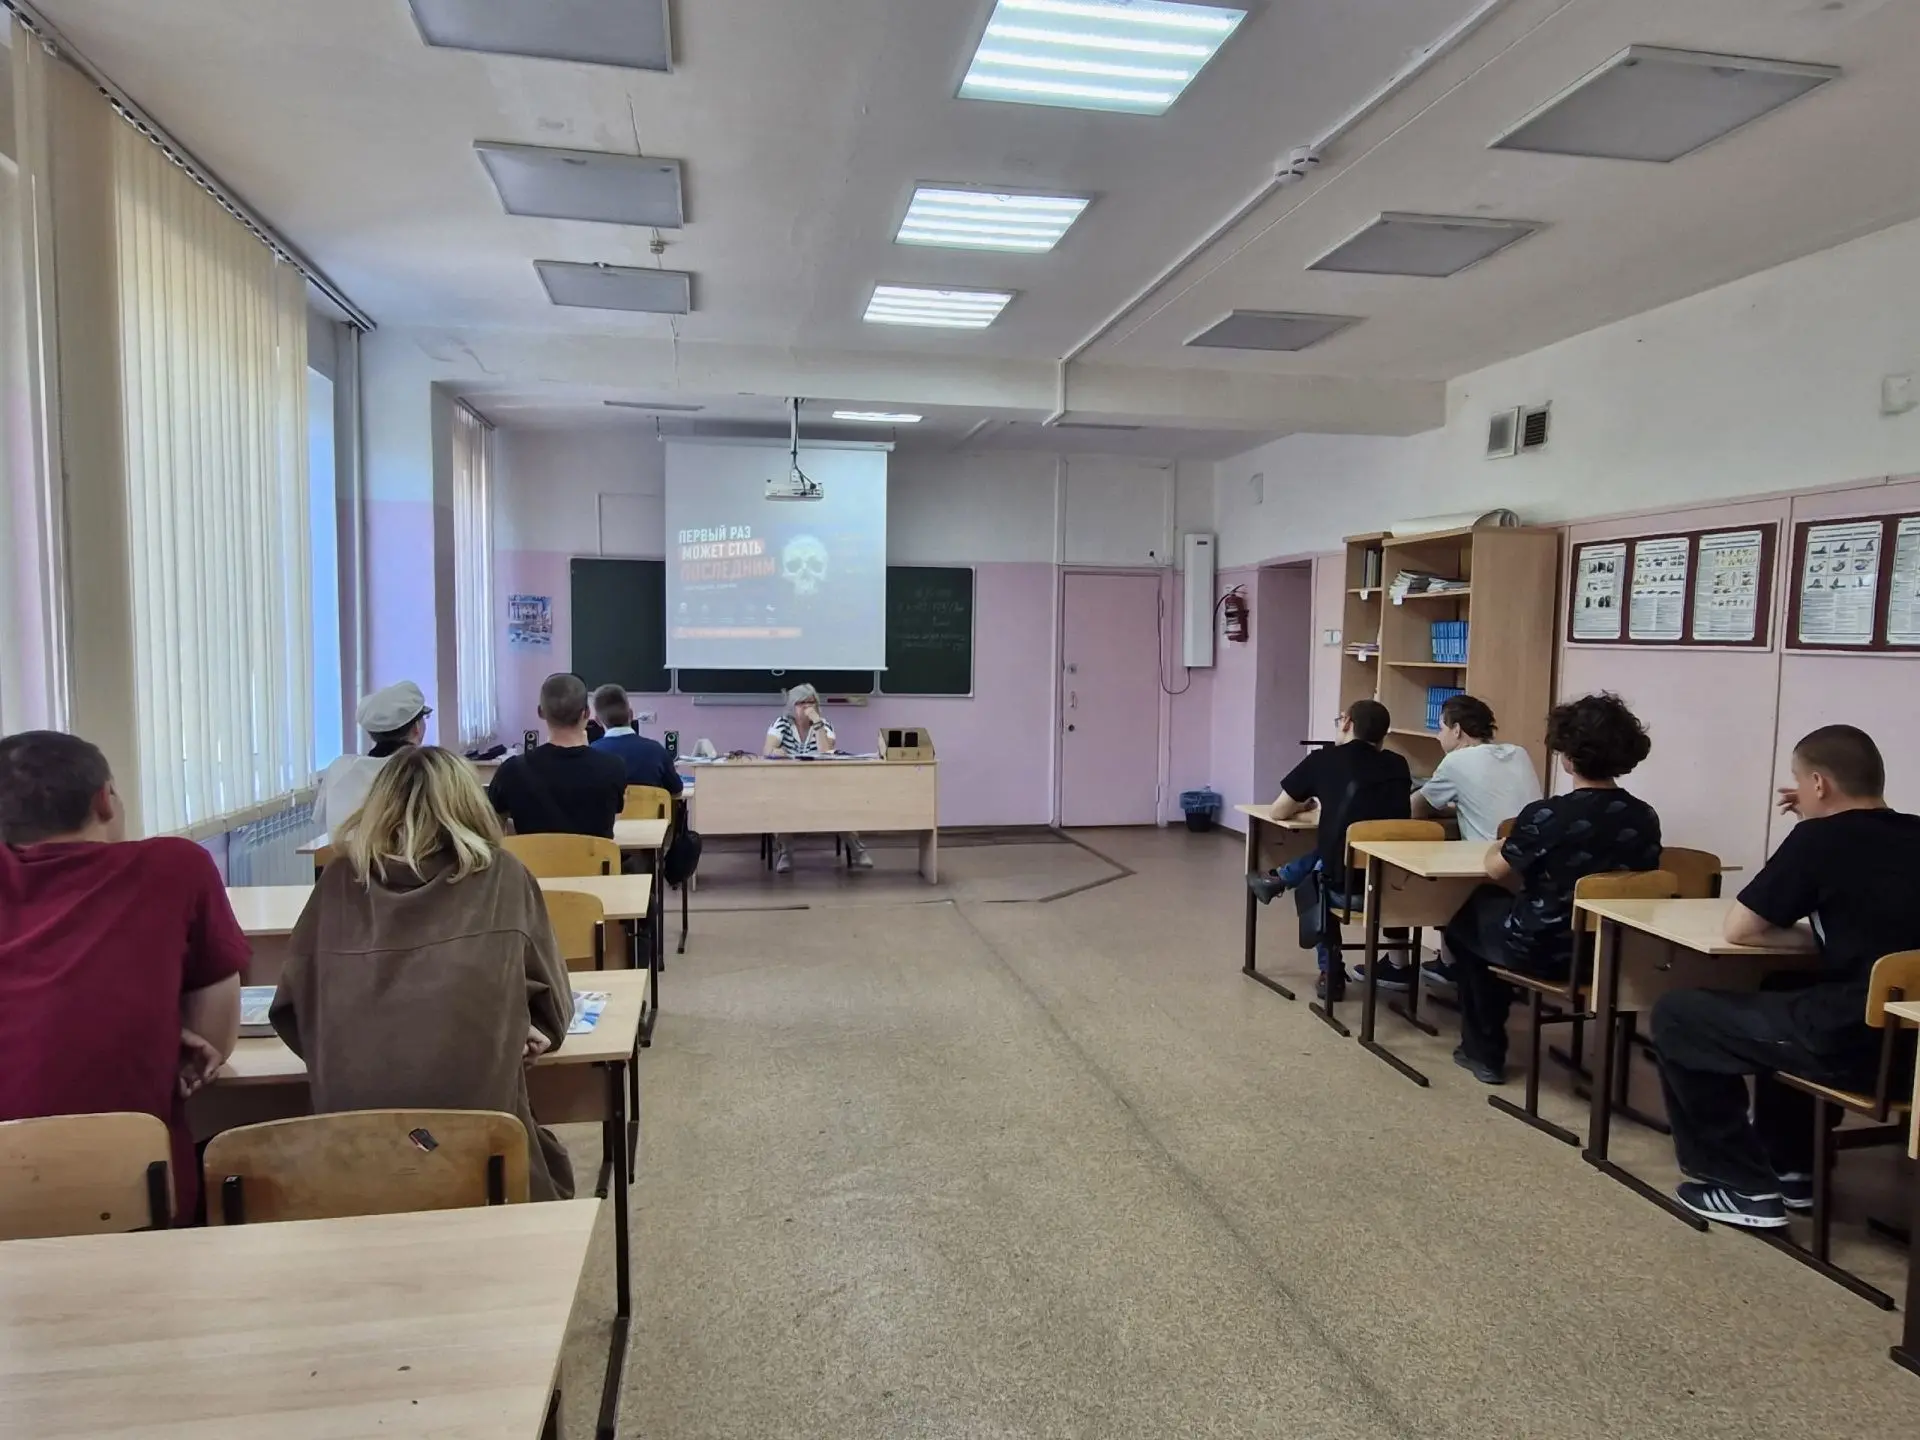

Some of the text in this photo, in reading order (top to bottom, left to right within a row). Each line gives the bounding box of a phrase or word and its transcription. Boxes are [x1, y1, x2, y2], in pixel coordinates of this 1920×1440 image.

[679, 525, 751, 544] ПЕРВЫЙ РАЗ
[682, 541, 762, 560] МОЖЕТ СТАТЬ
